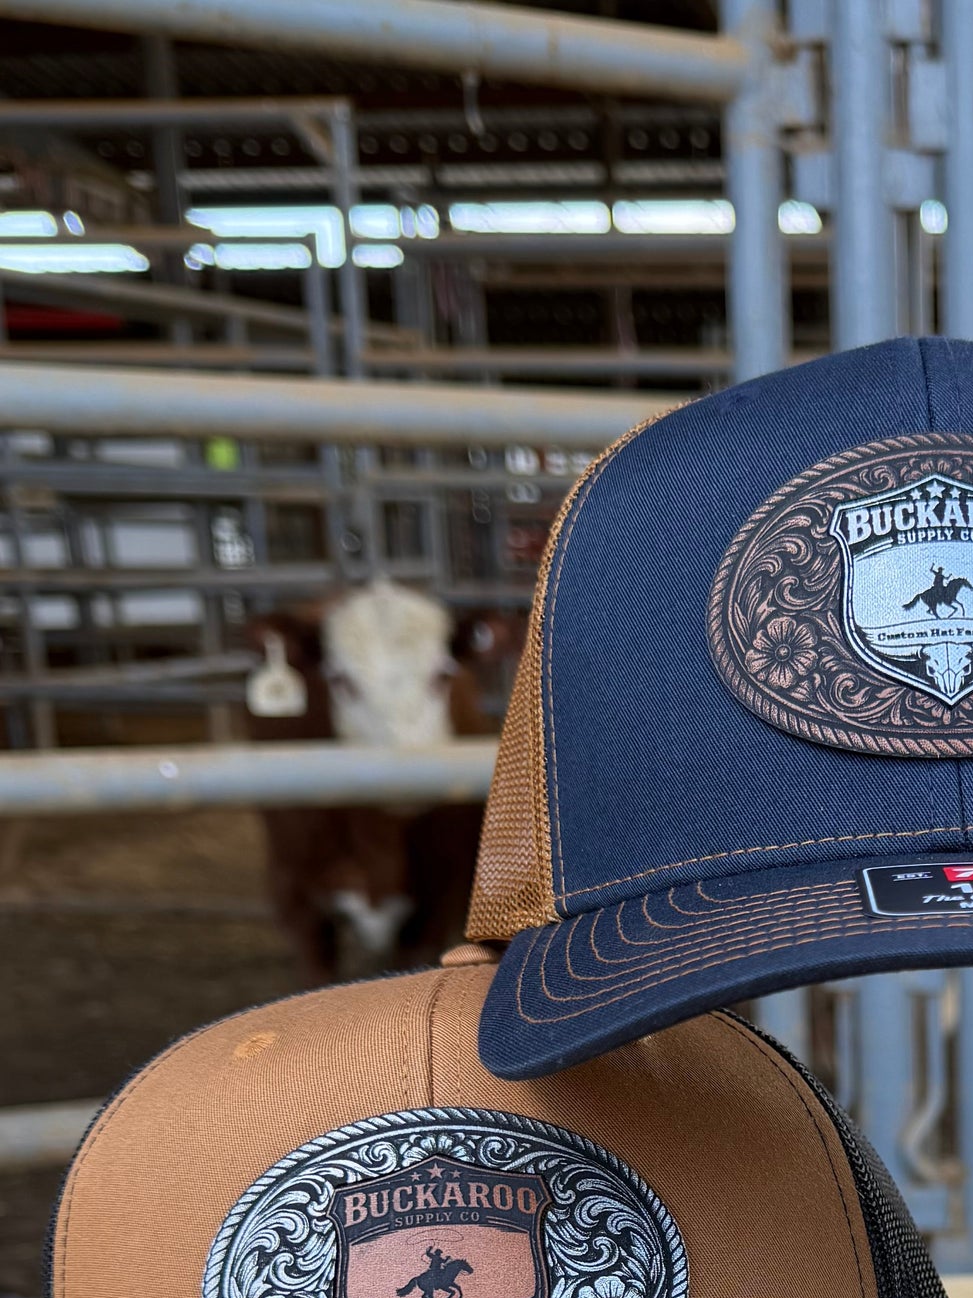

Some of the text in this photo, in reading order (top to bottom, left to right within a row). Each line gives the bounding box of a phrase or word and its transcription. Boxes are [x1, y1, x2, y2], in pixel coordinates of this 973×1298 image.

[897, 530, 953, 545] SUPPLY
[877, 630, 928, 642] Custom
[930, 628, 955, 638] Hat
[922, 893, 965, 904] The
[343, 1181, 539, 1228] BUCKAROO
[394, 1211, 480, 1227] SUPPLY CO
